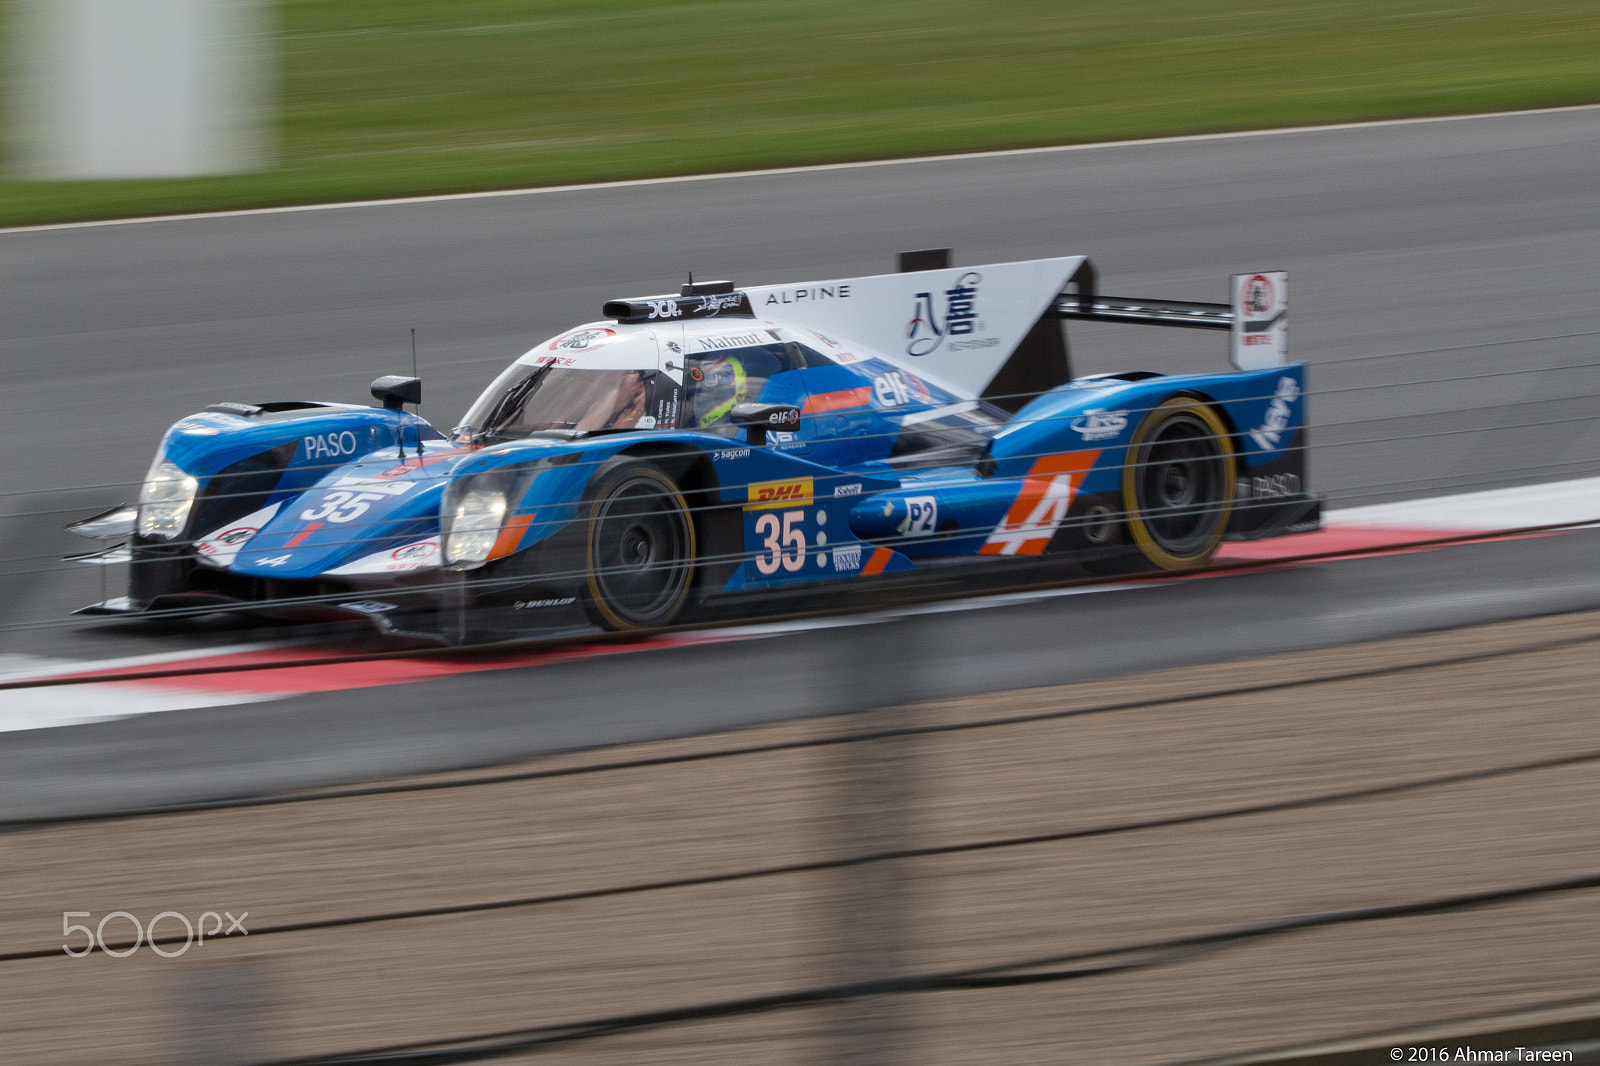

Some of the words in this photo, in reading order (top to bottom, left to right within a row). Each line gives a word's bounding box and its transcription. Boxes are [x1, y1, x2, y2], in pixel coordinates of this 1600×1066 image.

[765, 285, 850, 305] ALPINE
[698, 332, 762, 350] Matmut
[873, 371, 910, 407] elf
[769, 411, 788, 424] elf
[304, 431, 357, 460] PASO
[721, 449, 751, 460] sagcom
[757, 484, 804, 503] DHL
[299, 491, 386, 523] 35
[908, 502, 933, 531] P2
[755, 510, 806, 575] 35
[525, 597, 576, 609] DUNLOP
